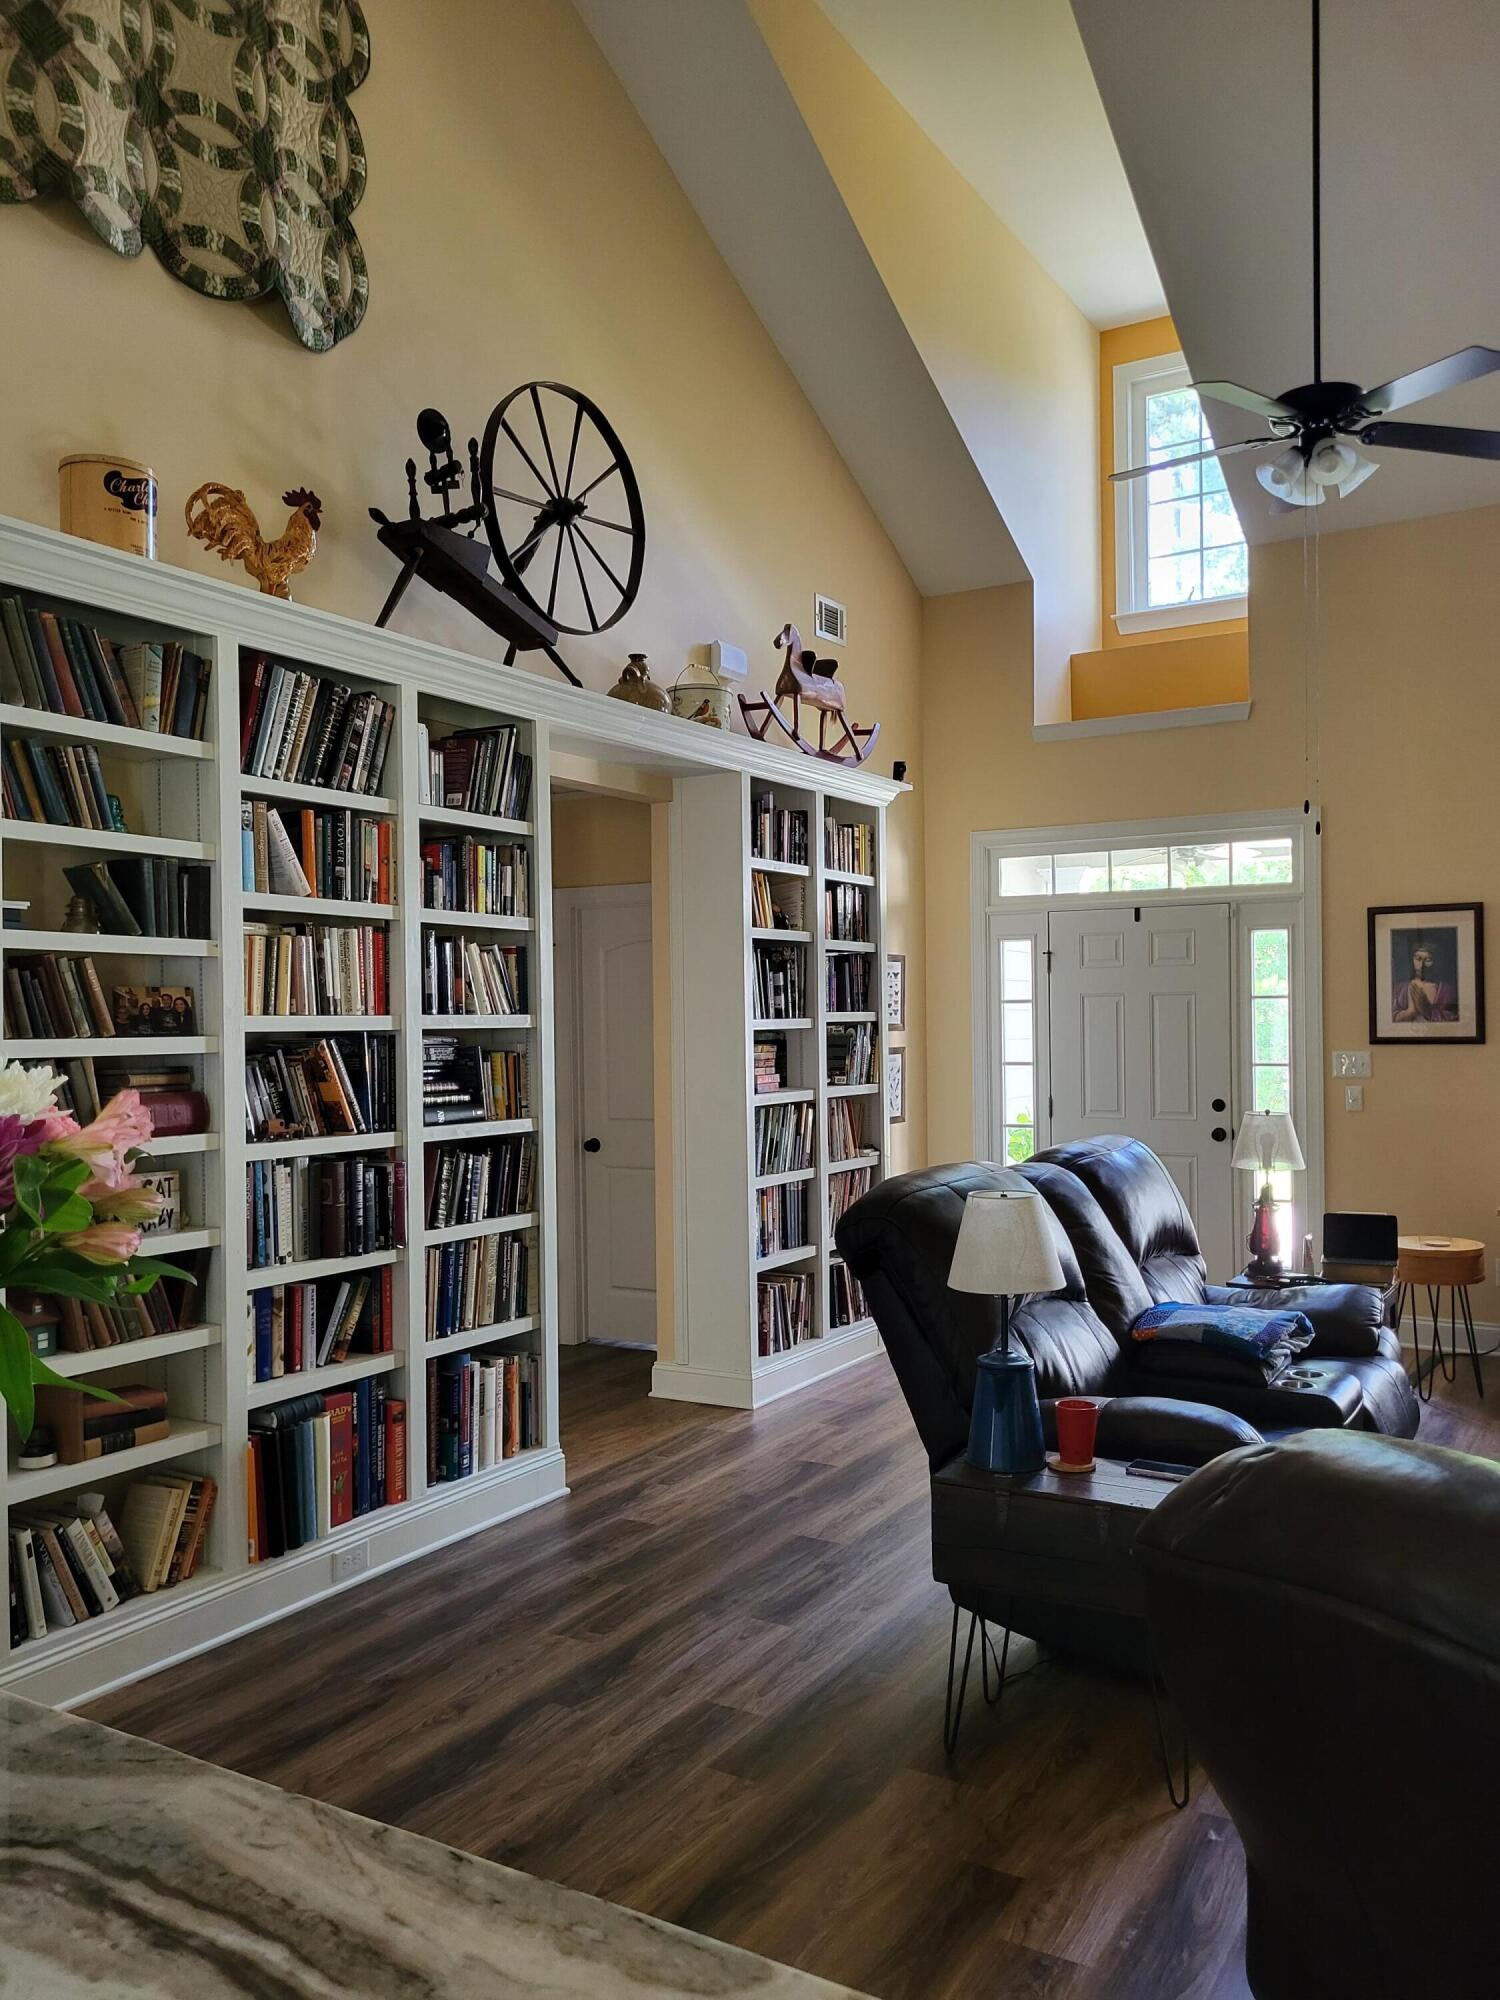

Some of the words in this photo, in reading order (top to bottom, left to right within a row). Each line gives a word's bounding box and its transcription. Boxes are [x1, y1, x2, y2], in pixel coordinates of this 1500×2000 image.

[110, 477, 150, 493] Charle
[285, 688, 302, 727] BATTLE
[278, 742, 288, 760] SEA
[314, 743, 326, 766] WAR
[337, 823, 345, 863] TOWER
[268, 1082, 282, 1114] AMERICA
[395, 1426, 403, 1458] MODERN
[395, 1460, 403, 1491] HISTORY
